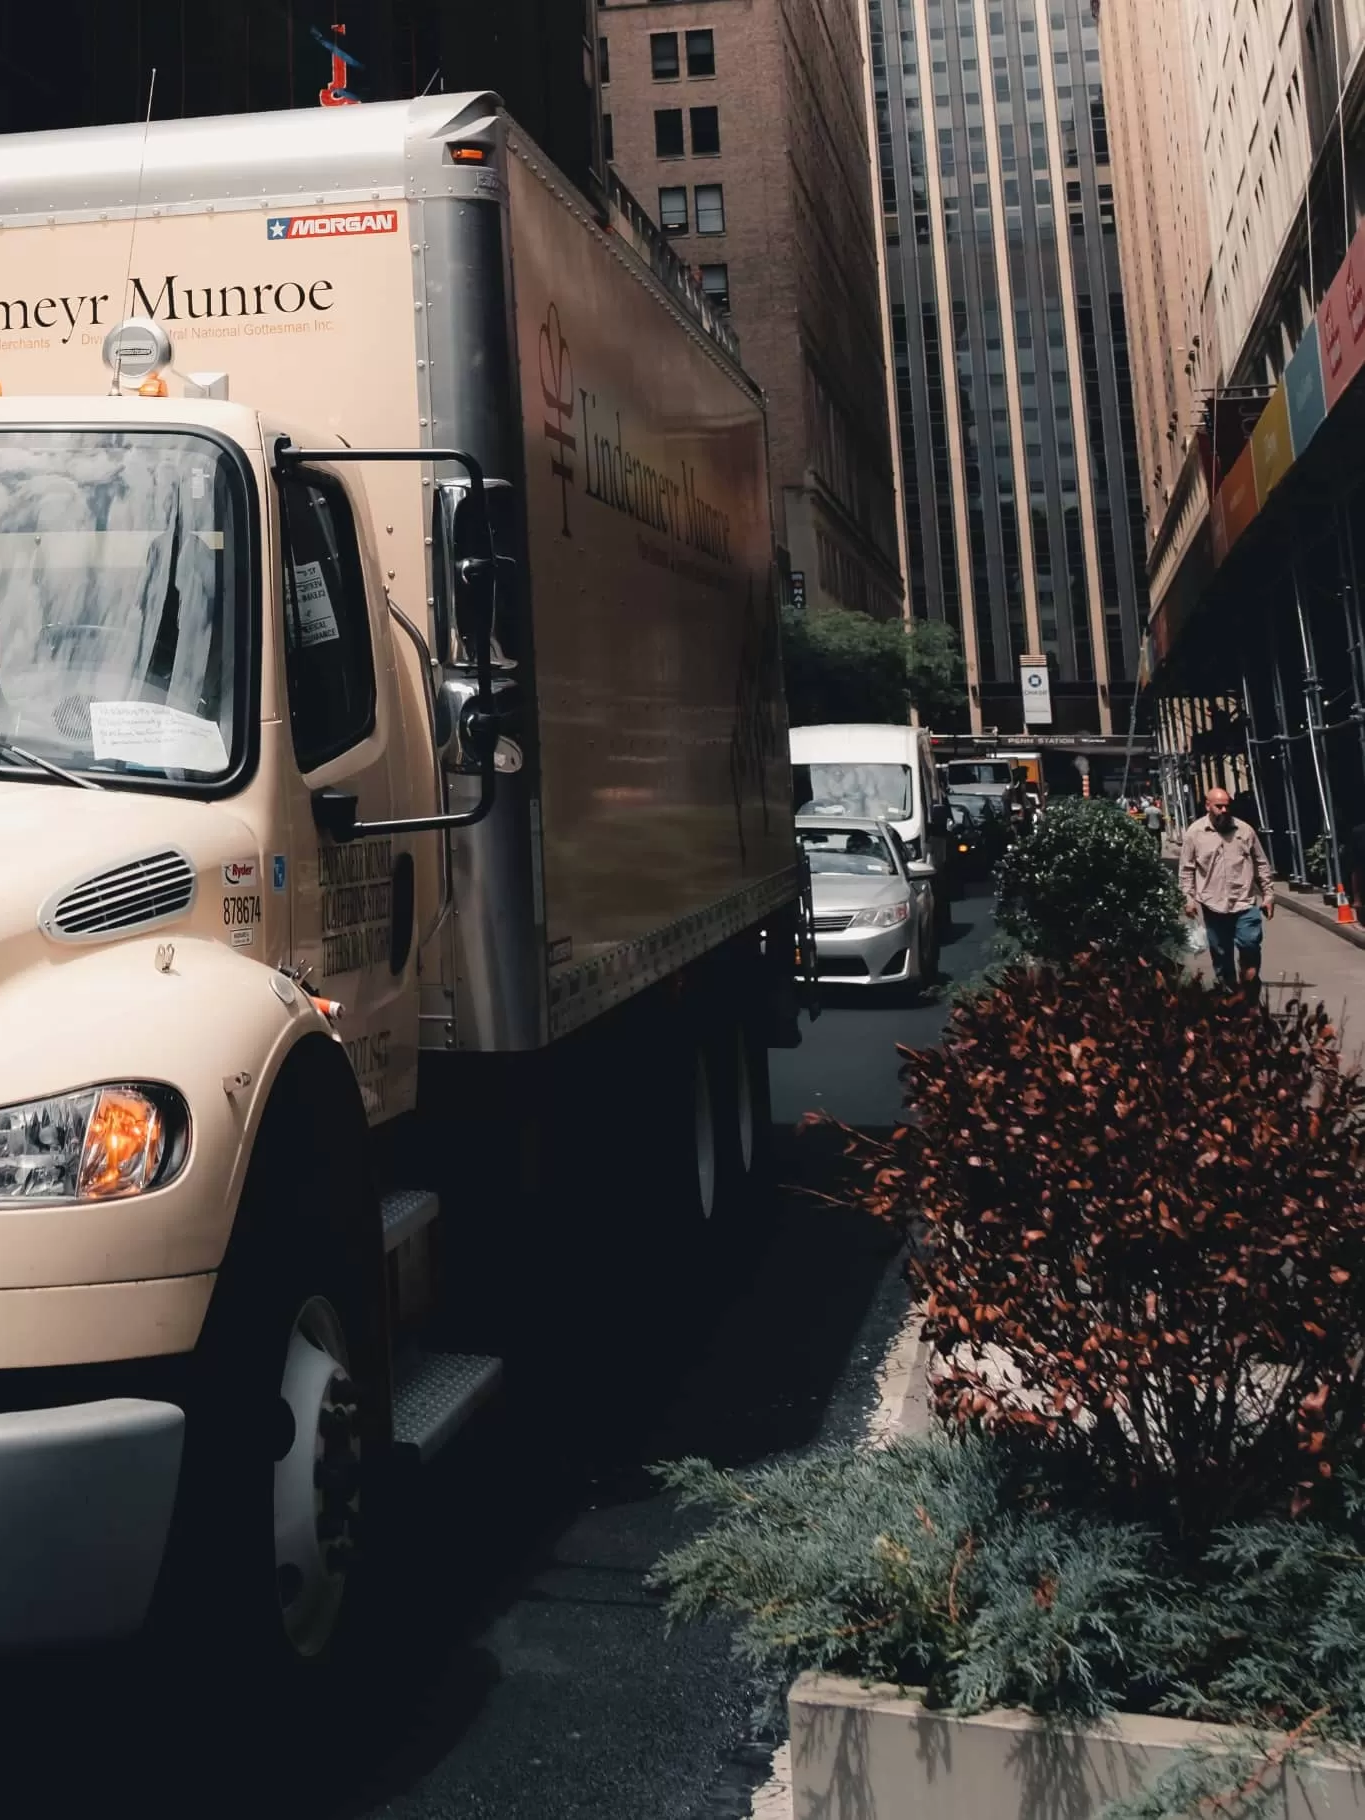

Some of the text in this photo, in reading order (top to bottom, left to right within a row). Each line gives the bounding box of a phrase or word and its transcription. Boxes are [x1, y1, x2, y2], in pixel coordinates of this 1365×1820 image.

[291, 214, 394, 236] MORGAN
[128, 274, 335, 320] Munroe
[191, 326, 240, 339] National
[1037, 737, 1075, 745] STATION
[231, 863, 254, 879] Ryder
[223, 895, 261, 925] 878674
